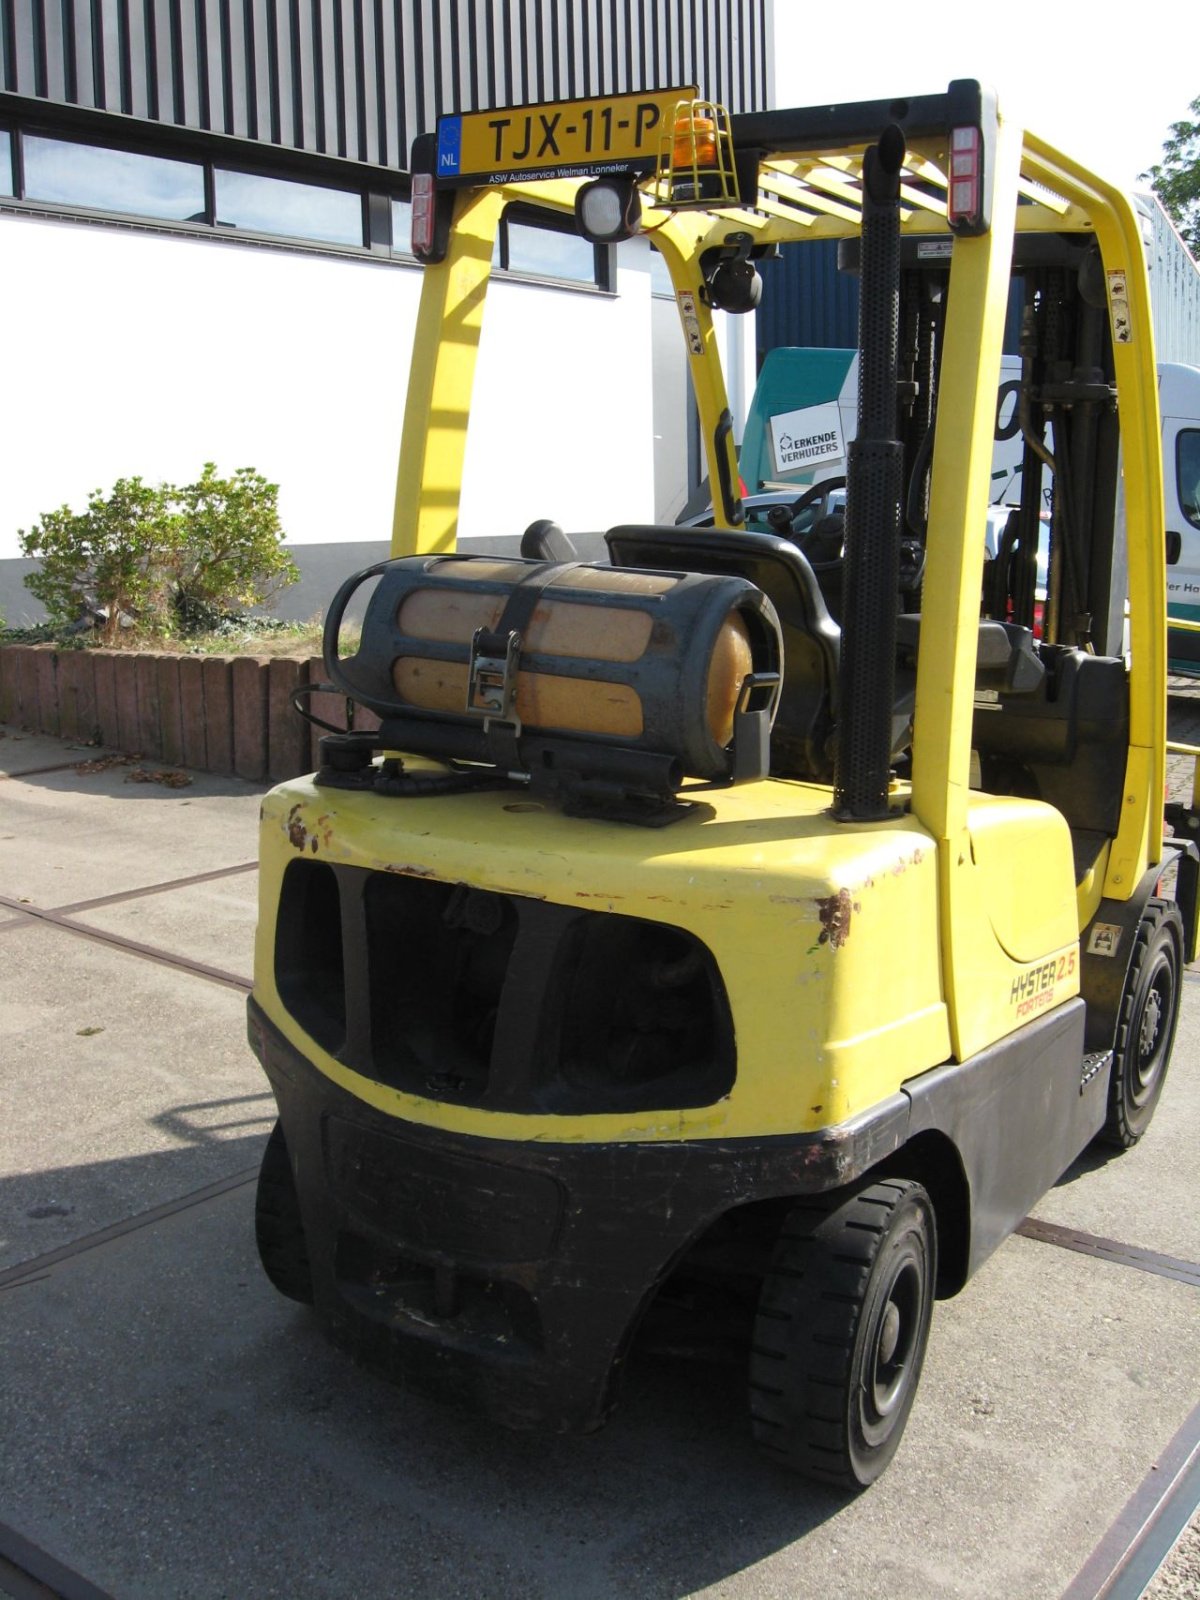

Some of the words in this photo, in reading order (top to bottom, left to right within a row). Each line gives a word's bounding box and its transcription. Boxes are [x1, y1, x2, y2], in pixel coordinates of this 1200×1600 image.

[488, 102, 660, 162] TJX-11-P
[440, 153, 457, 167] NL
[489, 173, 508, 184] ASW
[509, 170, 556, 182] Autoservice
[557, 166, 589, 177] Welman
[590, 163, 629, 175] Lonneker
[794, 430, 837, 450] ERKENDE
[781, 441, 839, 464] VERHUIZERS
[1009, 960, 1057, 1005] HYSTER
[1056, 951, 1077, 982] 2.5
